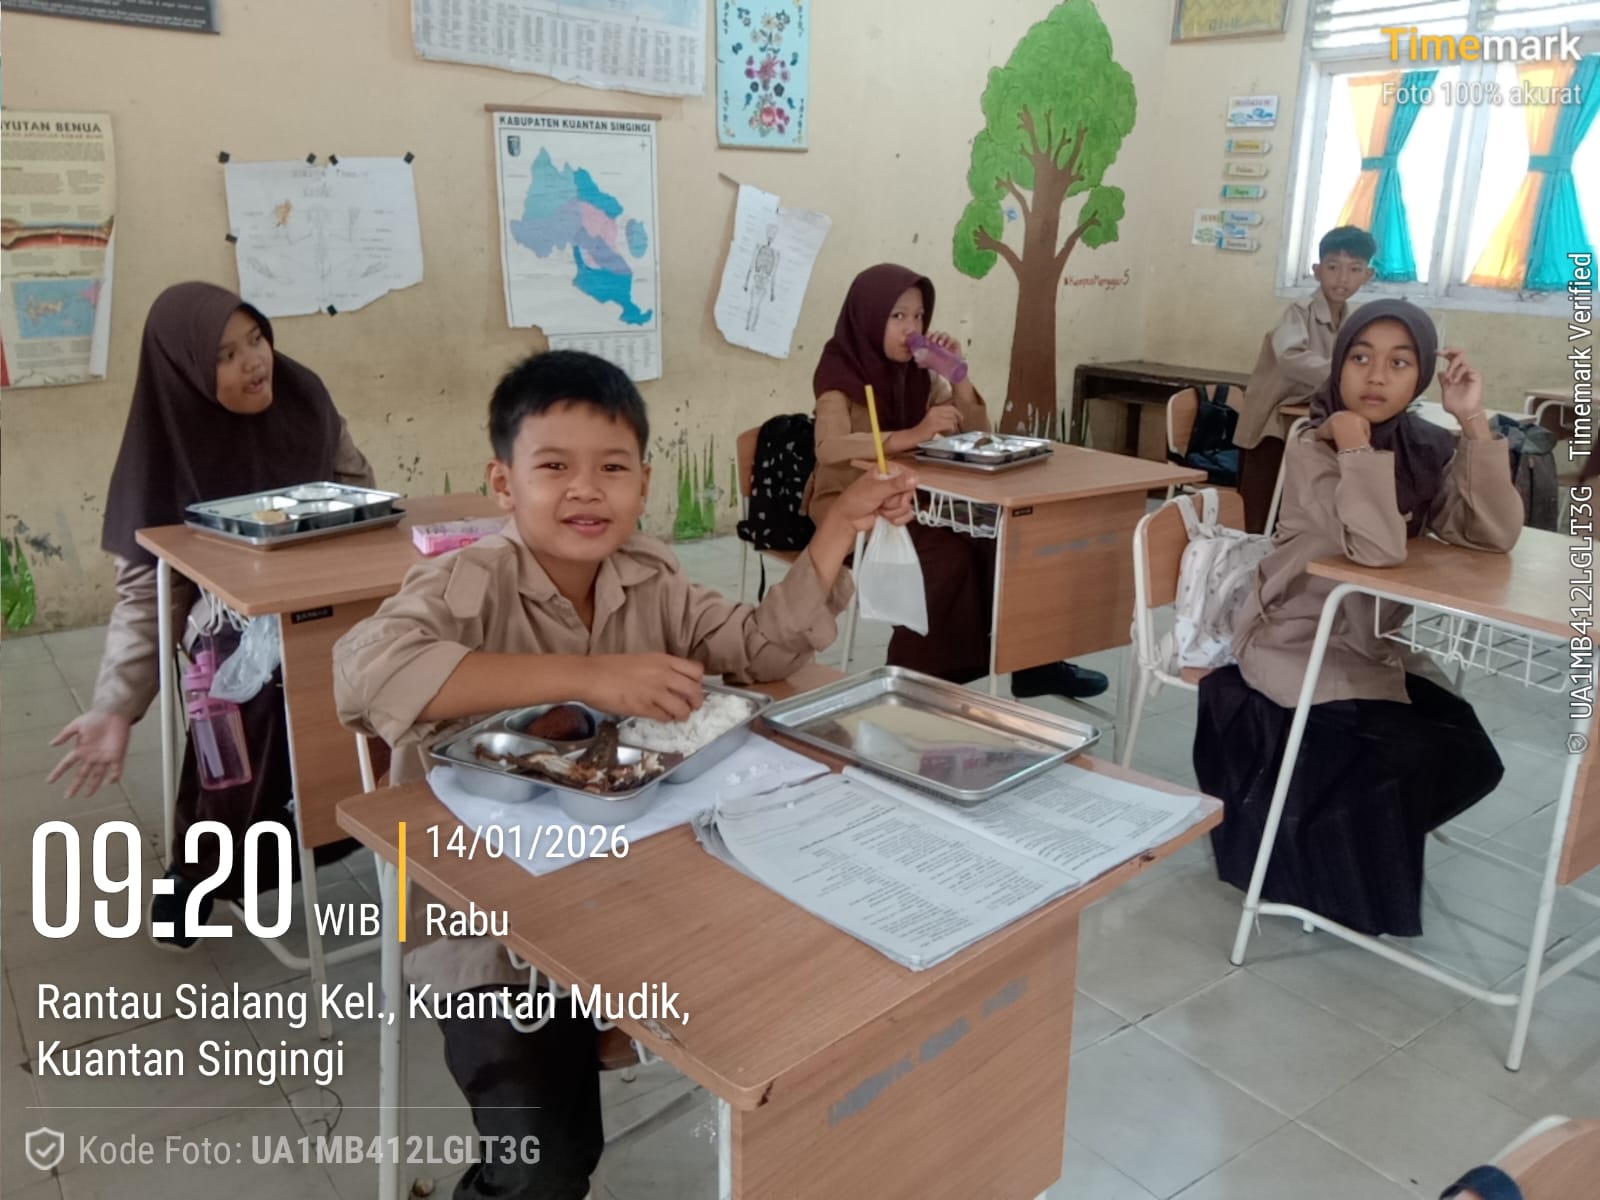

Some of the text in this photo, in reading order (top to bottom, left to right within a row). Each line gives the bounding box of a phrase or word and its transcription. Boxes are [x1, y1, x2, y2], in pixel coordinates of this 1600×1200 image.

[1, 119, 102, 132] YUTAN BENUA
[499, 116, 651, 133] KABUPATEN KUANTAN SINGINGI
